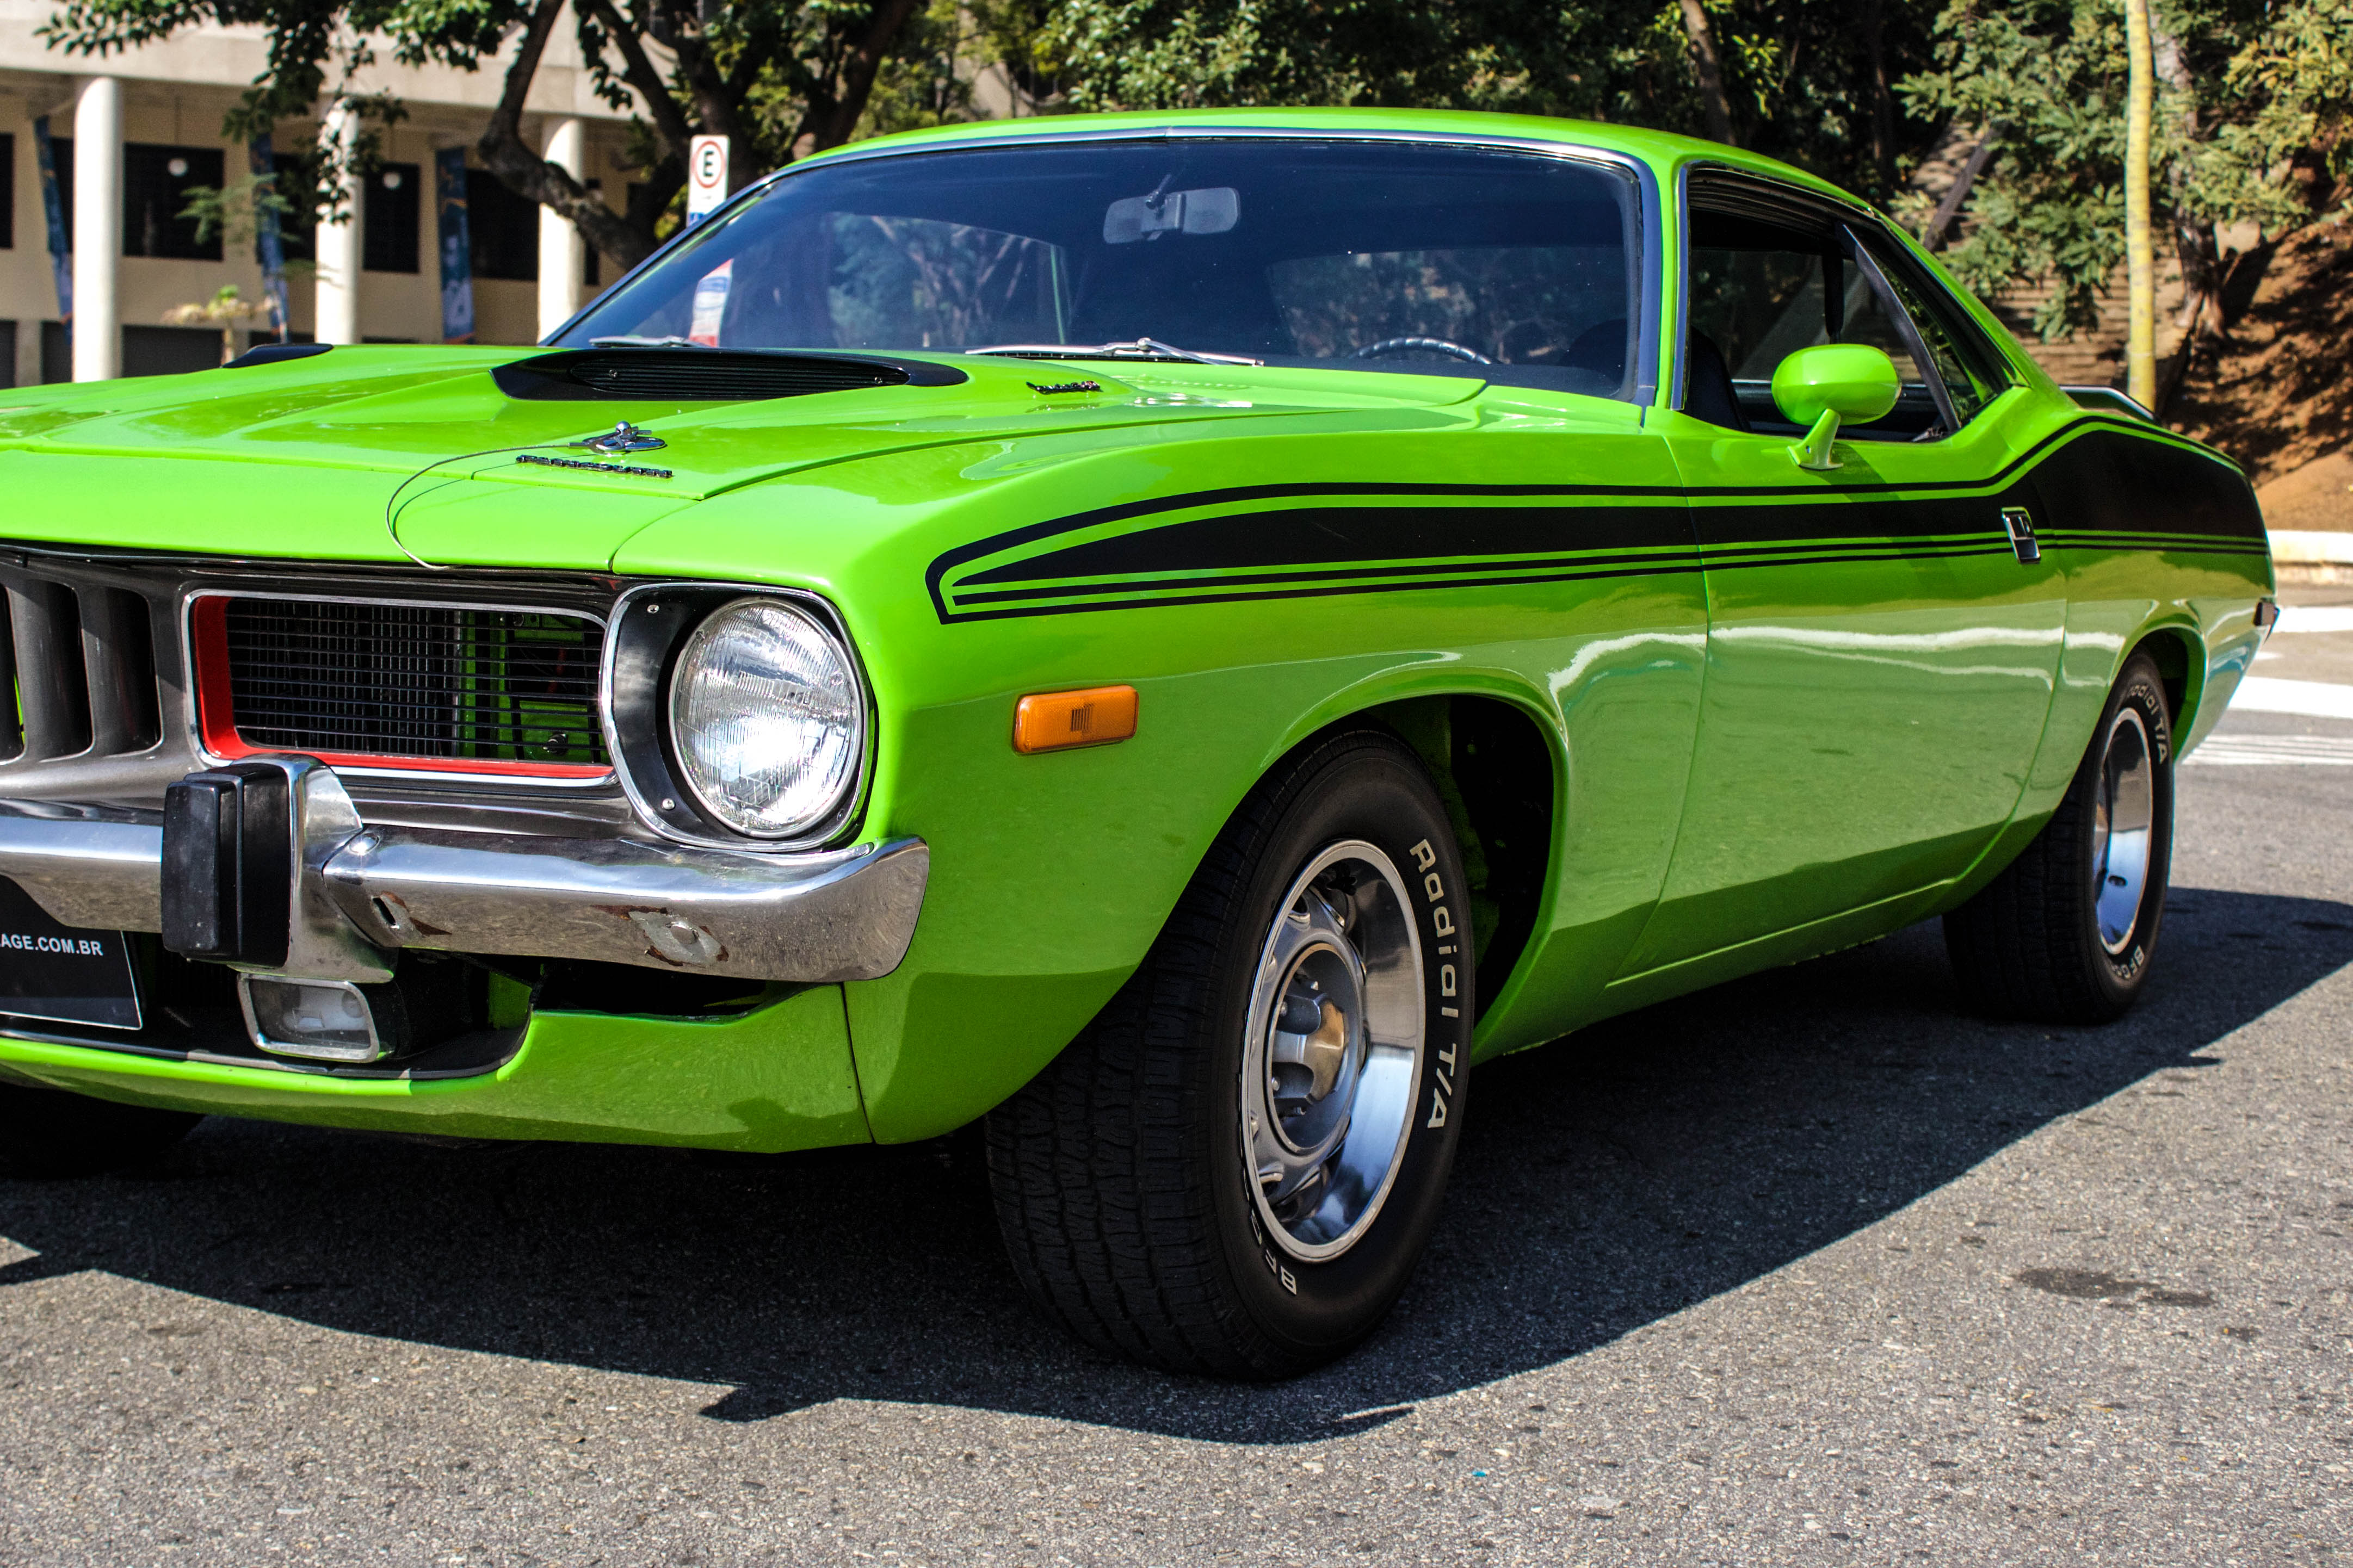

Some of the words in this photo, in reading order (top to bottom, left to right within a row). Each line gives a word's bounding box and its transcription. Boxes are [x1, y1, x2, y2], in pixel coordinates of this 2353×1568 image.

[703, 150, 714, 177] E
[0, 933, 104, 957] AGE.COM.BR
[1409, 838, 1459, 1018] Radial
[1426, 1043, 1457, 1129] T/A
